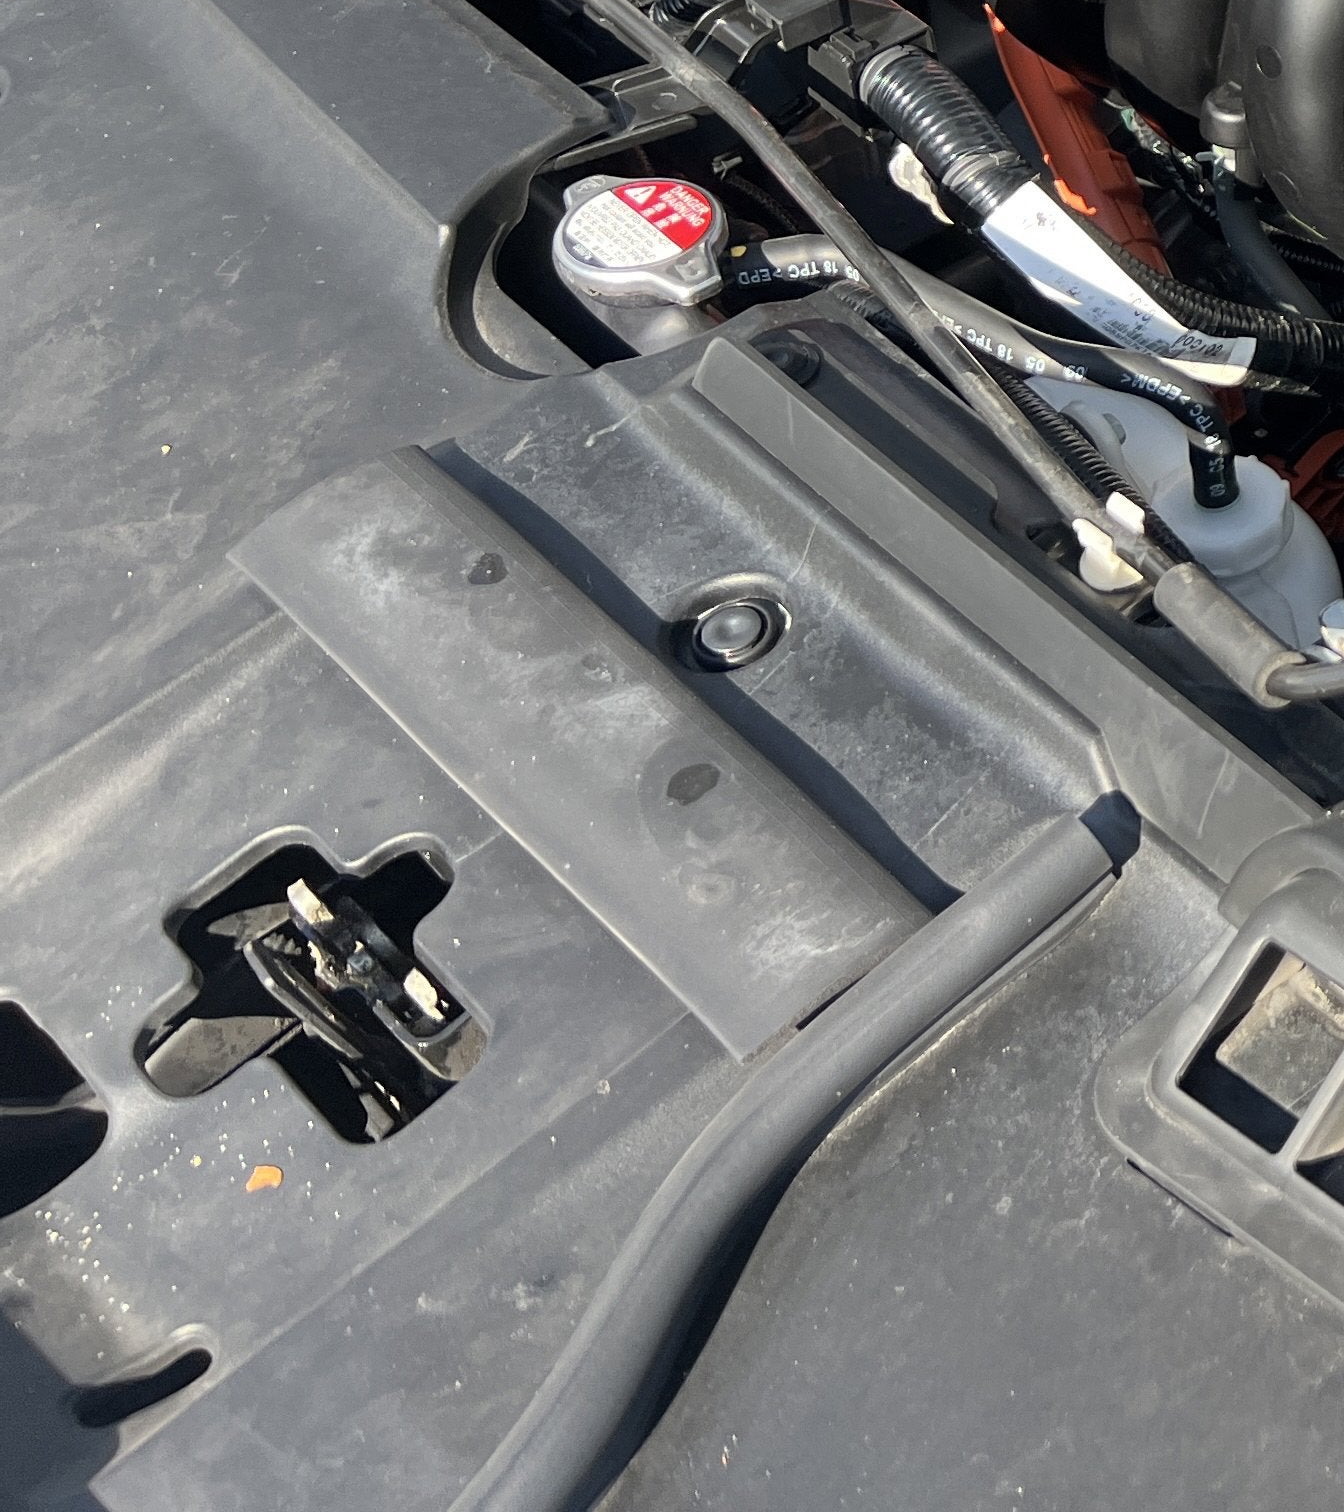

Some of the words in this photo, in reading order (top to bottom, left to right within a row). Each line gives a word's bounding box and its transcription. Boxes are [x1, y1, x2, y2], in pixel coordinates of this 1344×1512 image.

[671, 185, 711, 214] DANGER
[788, 261, 820, 280] TPC
[822, 260, 839, 276] 18
[966, 328, 993, 353] TPC
[996, 347, 1014, 362] 18
[1024, 355, 1046, 373] 05
[1189, 403, 1214, 434] TPC
